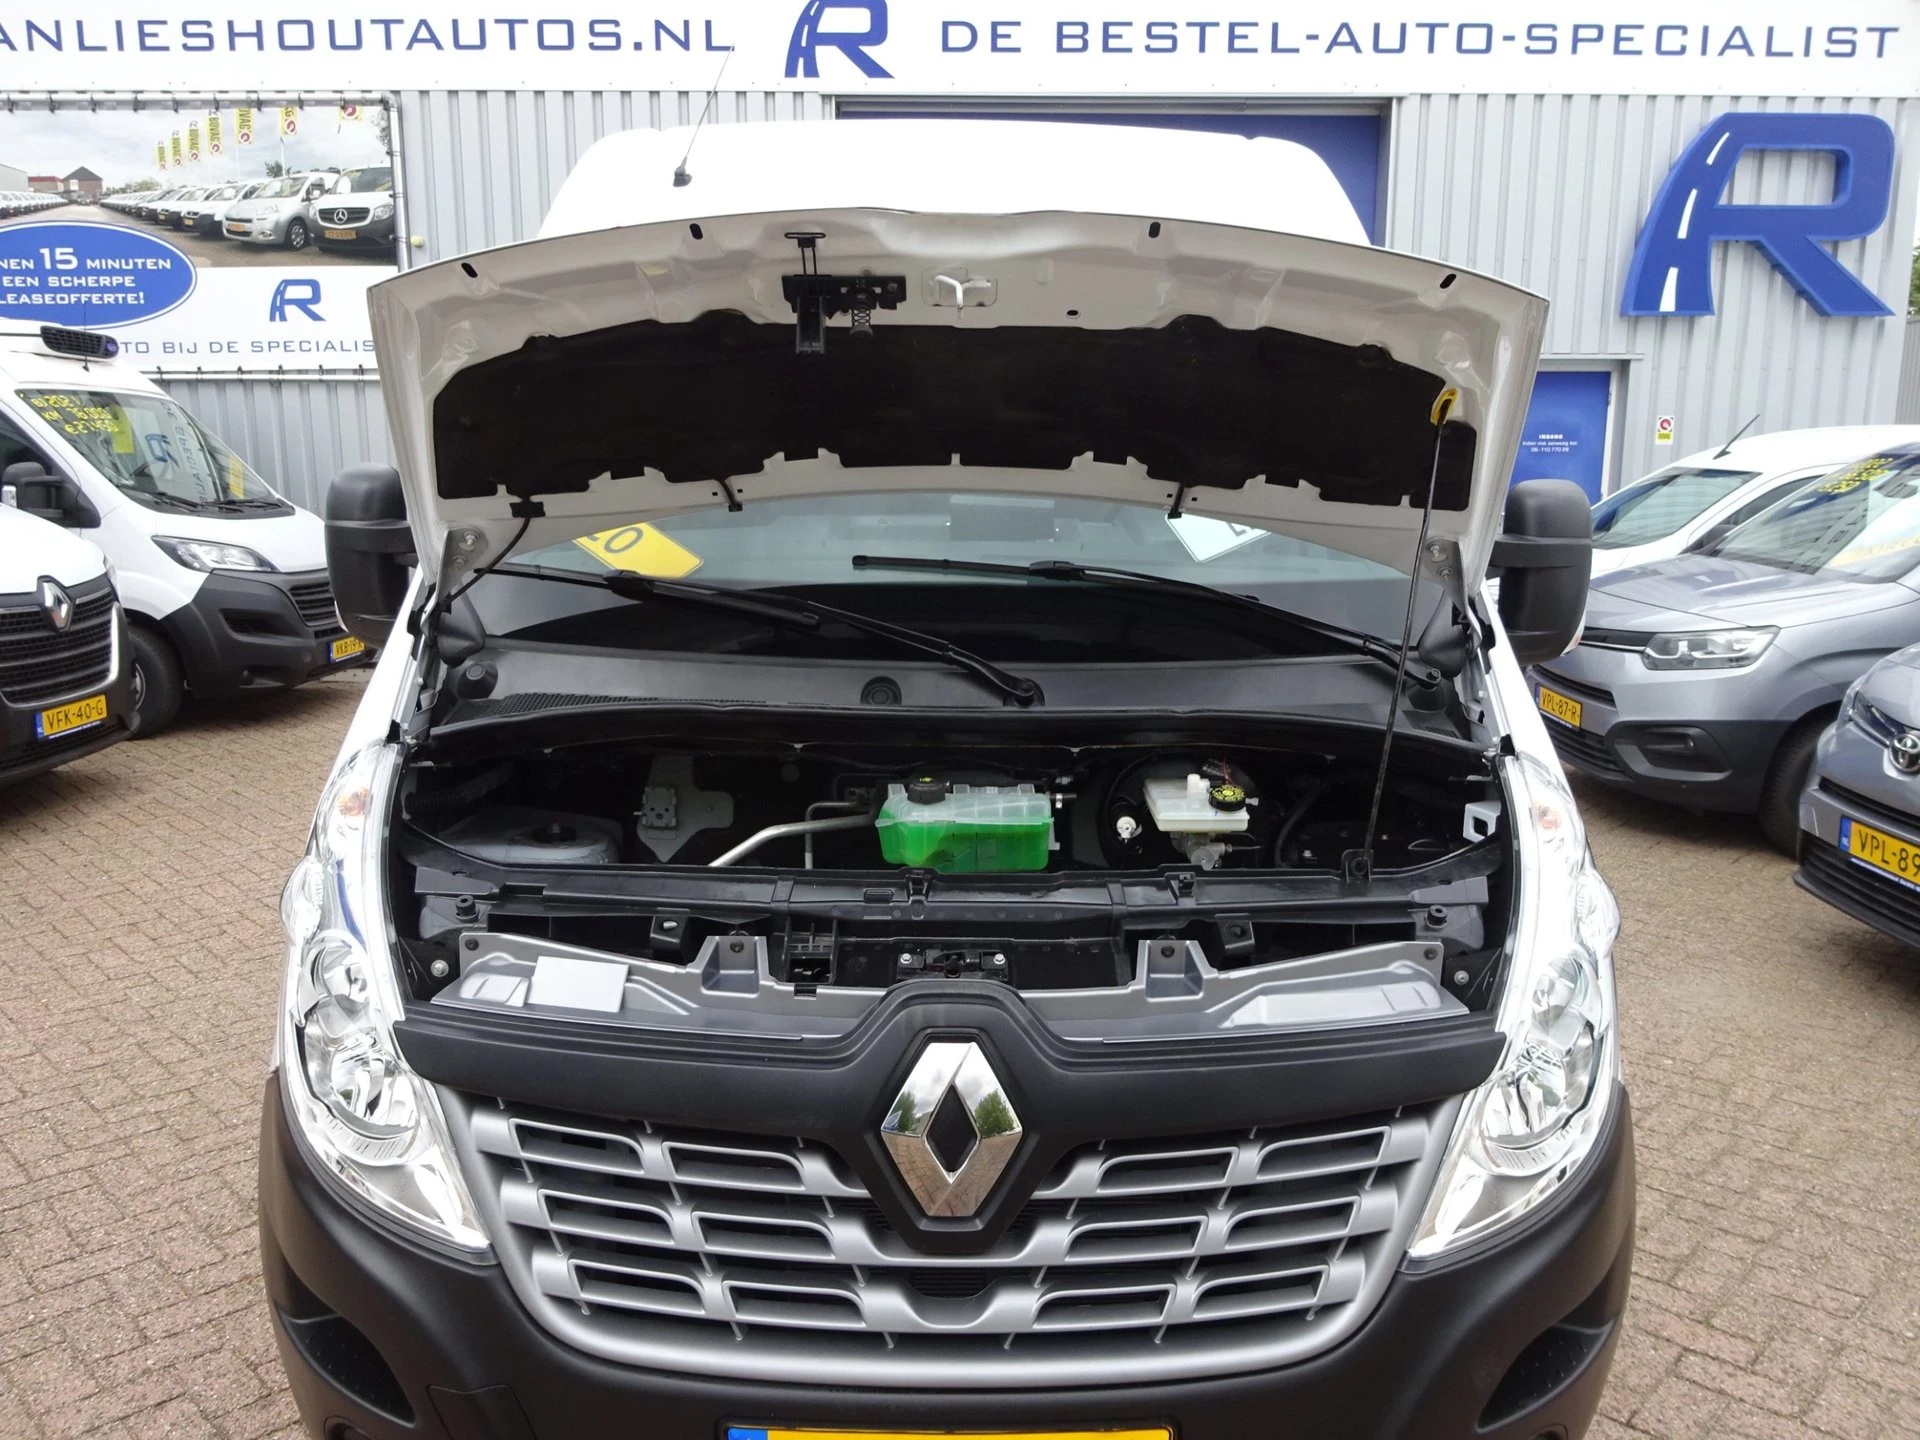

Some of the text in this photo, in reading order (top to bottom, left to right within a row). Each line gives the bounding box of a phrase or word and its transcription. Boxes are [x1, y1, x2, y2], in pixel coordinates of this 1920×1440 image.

[941, 20, 1899, 58] DE BESTEL-AUTO-SPECIALIST
[39, 247, 79, 270] 15
[86, 258, 171, 270] MINUTEN
[2, 276, 136, 288] EEN SCHERPE
[162, 341, 198, 354] BIJ
[209, 341, 239, 353] DE
[46, 698, 104, 731] VFK-40-G
